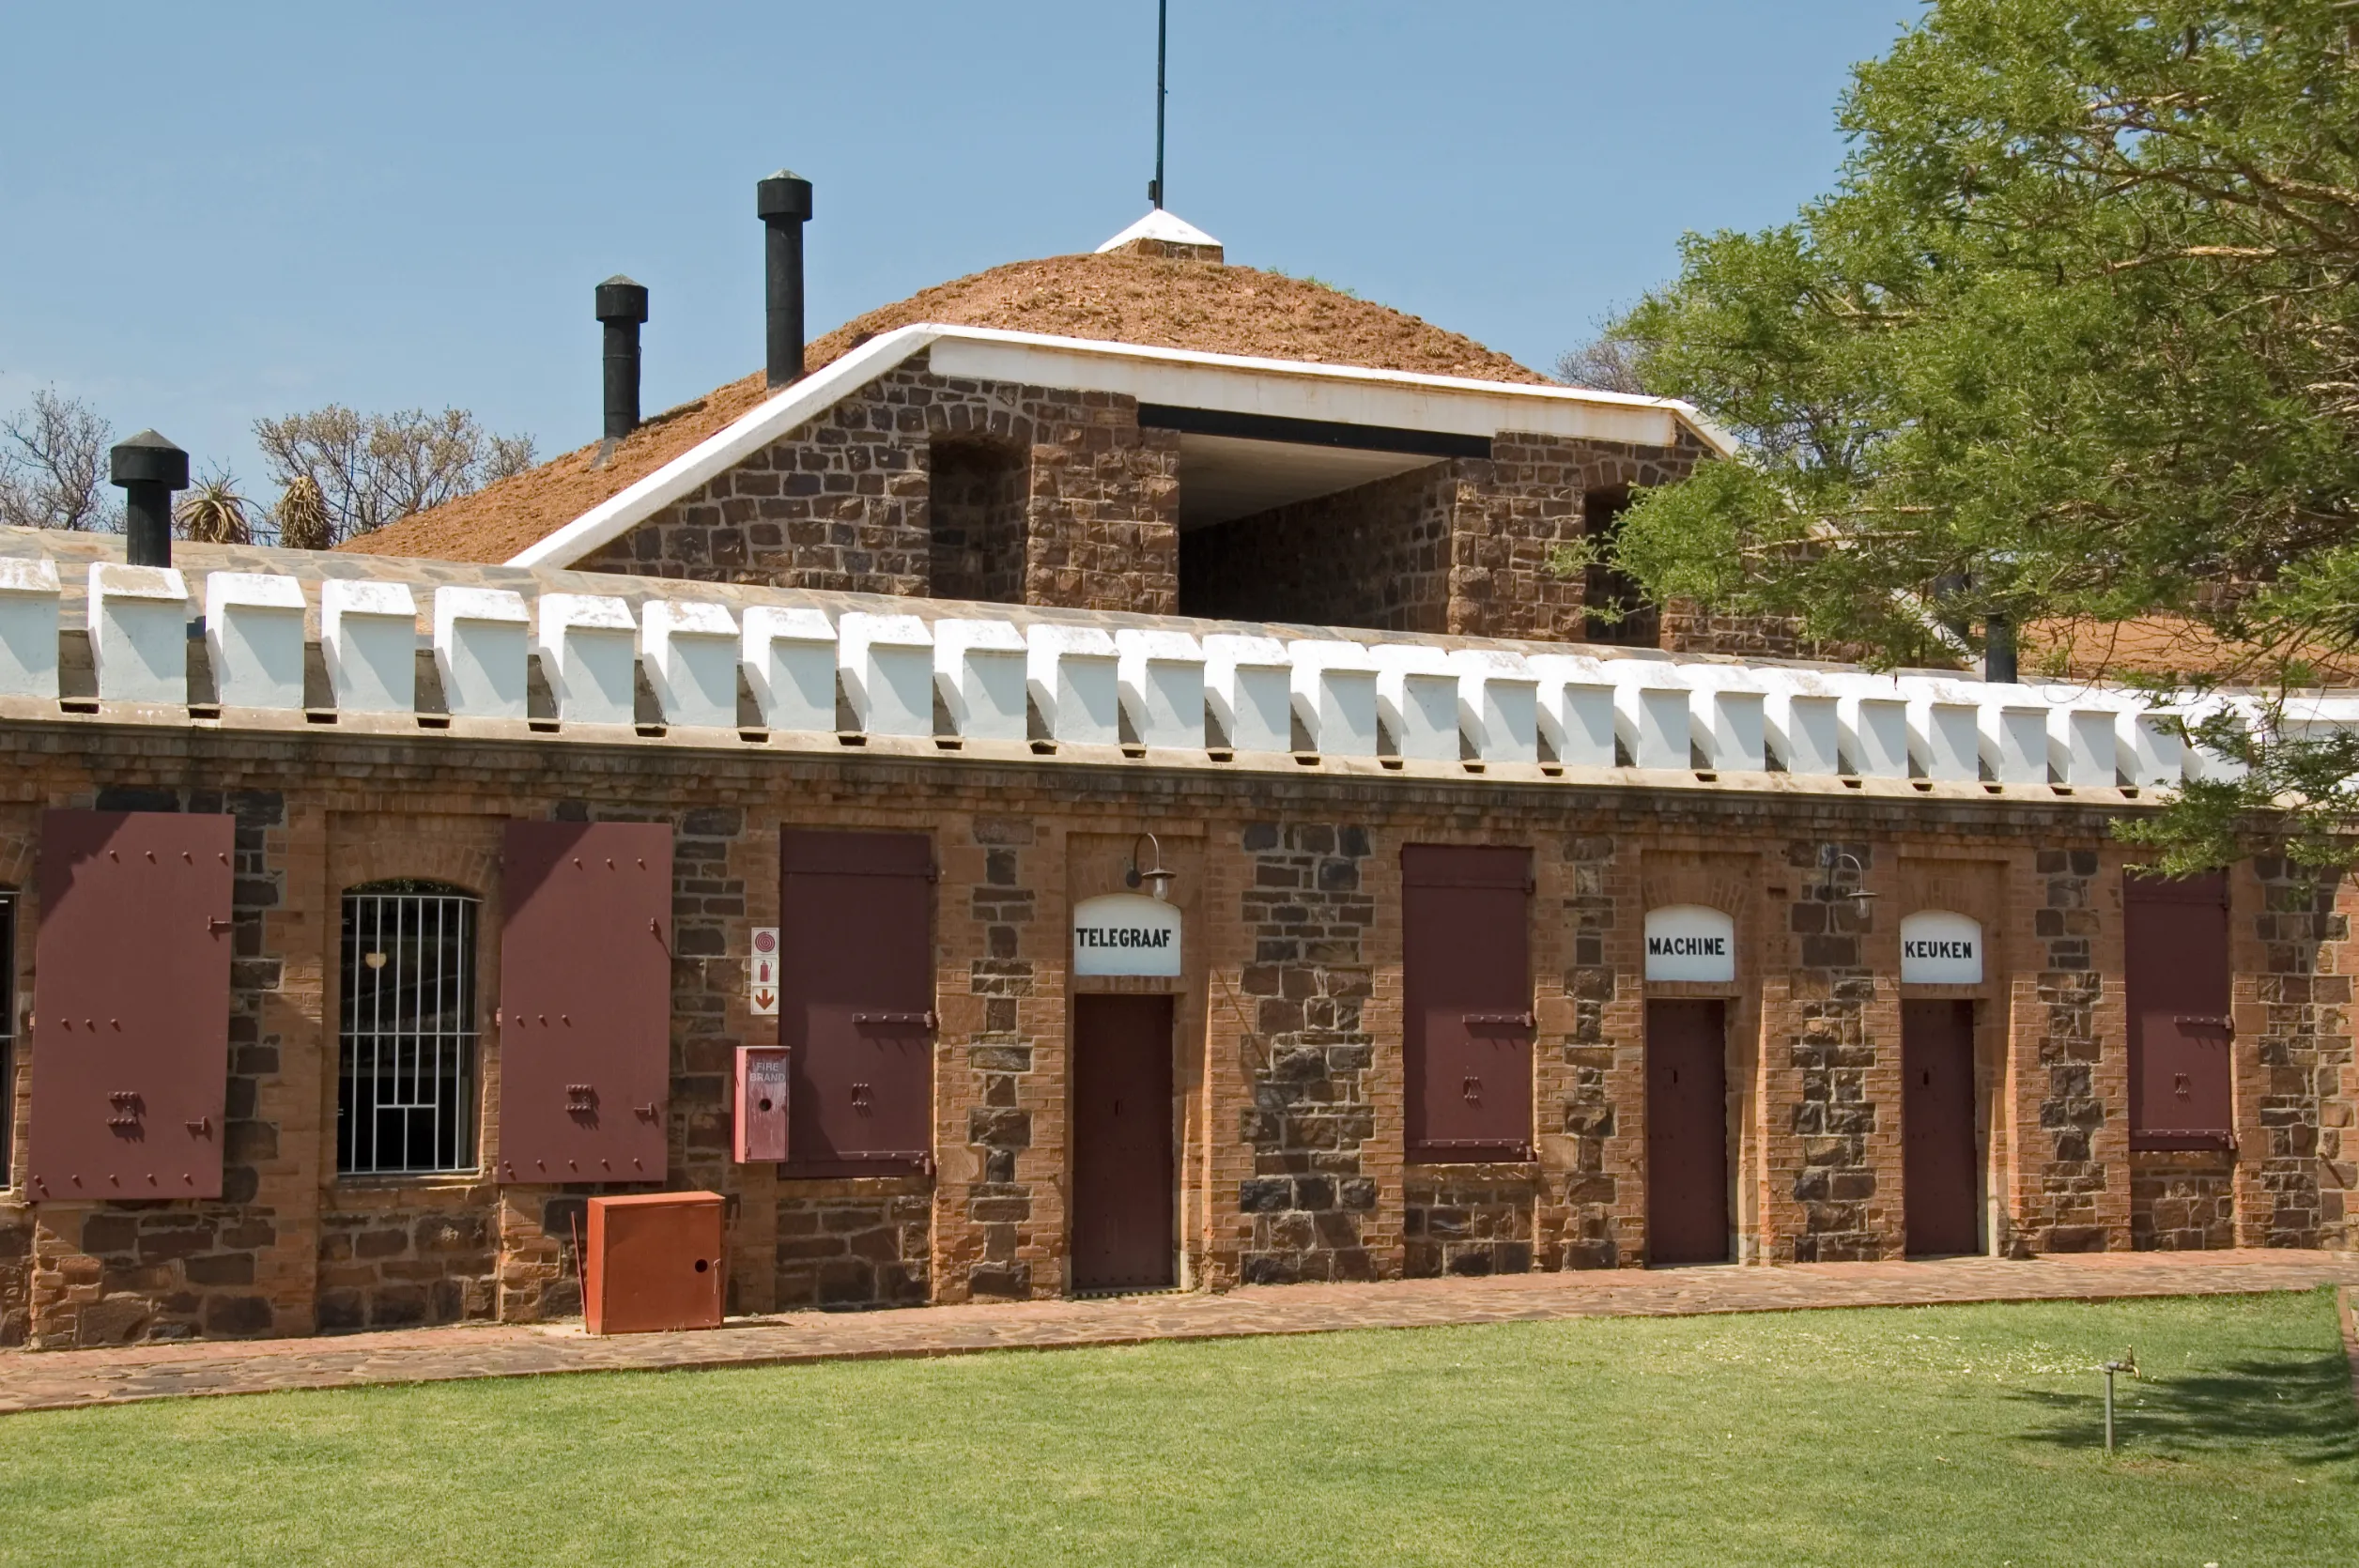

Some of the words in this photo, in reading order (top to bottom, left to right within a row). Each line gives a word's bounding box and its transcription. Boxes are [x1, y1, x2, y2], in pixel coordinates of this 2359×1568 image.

[1076, 928, 1171, 947] TELEGRAAF
[1649, 937, 1725, 956] MACHINE
[1904, 941, 1972, 959] KEUKEN
[756, 1062, 779, 1071] FIRE
[749, 1072, 785, 1082] BRAND
